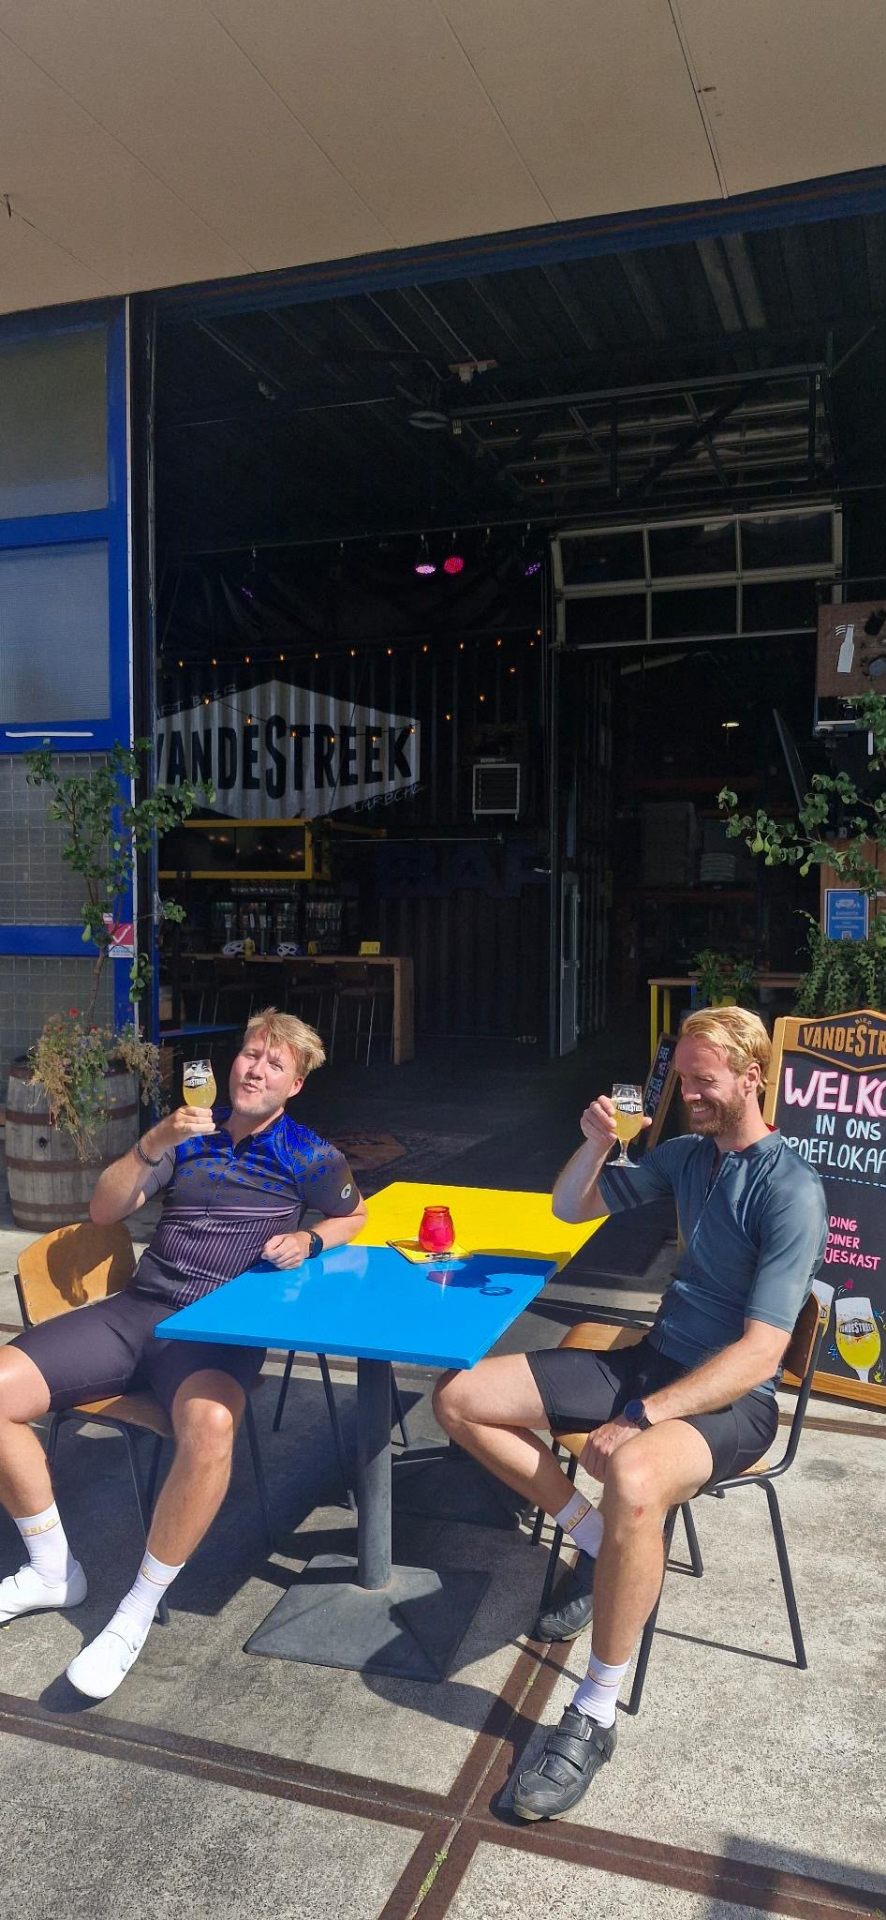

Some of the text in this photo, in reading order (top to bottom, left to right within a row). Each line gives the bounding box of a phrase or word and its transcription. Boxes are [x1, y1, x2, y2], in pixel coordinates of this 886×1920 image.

[815, 1113, 881, 1141] IN ONS
[780, 1135, 886, 1174] ROEFLOKAA
[828, 1215, 858, 1232] DING
[827, 1232, 860, 1249] DINER
